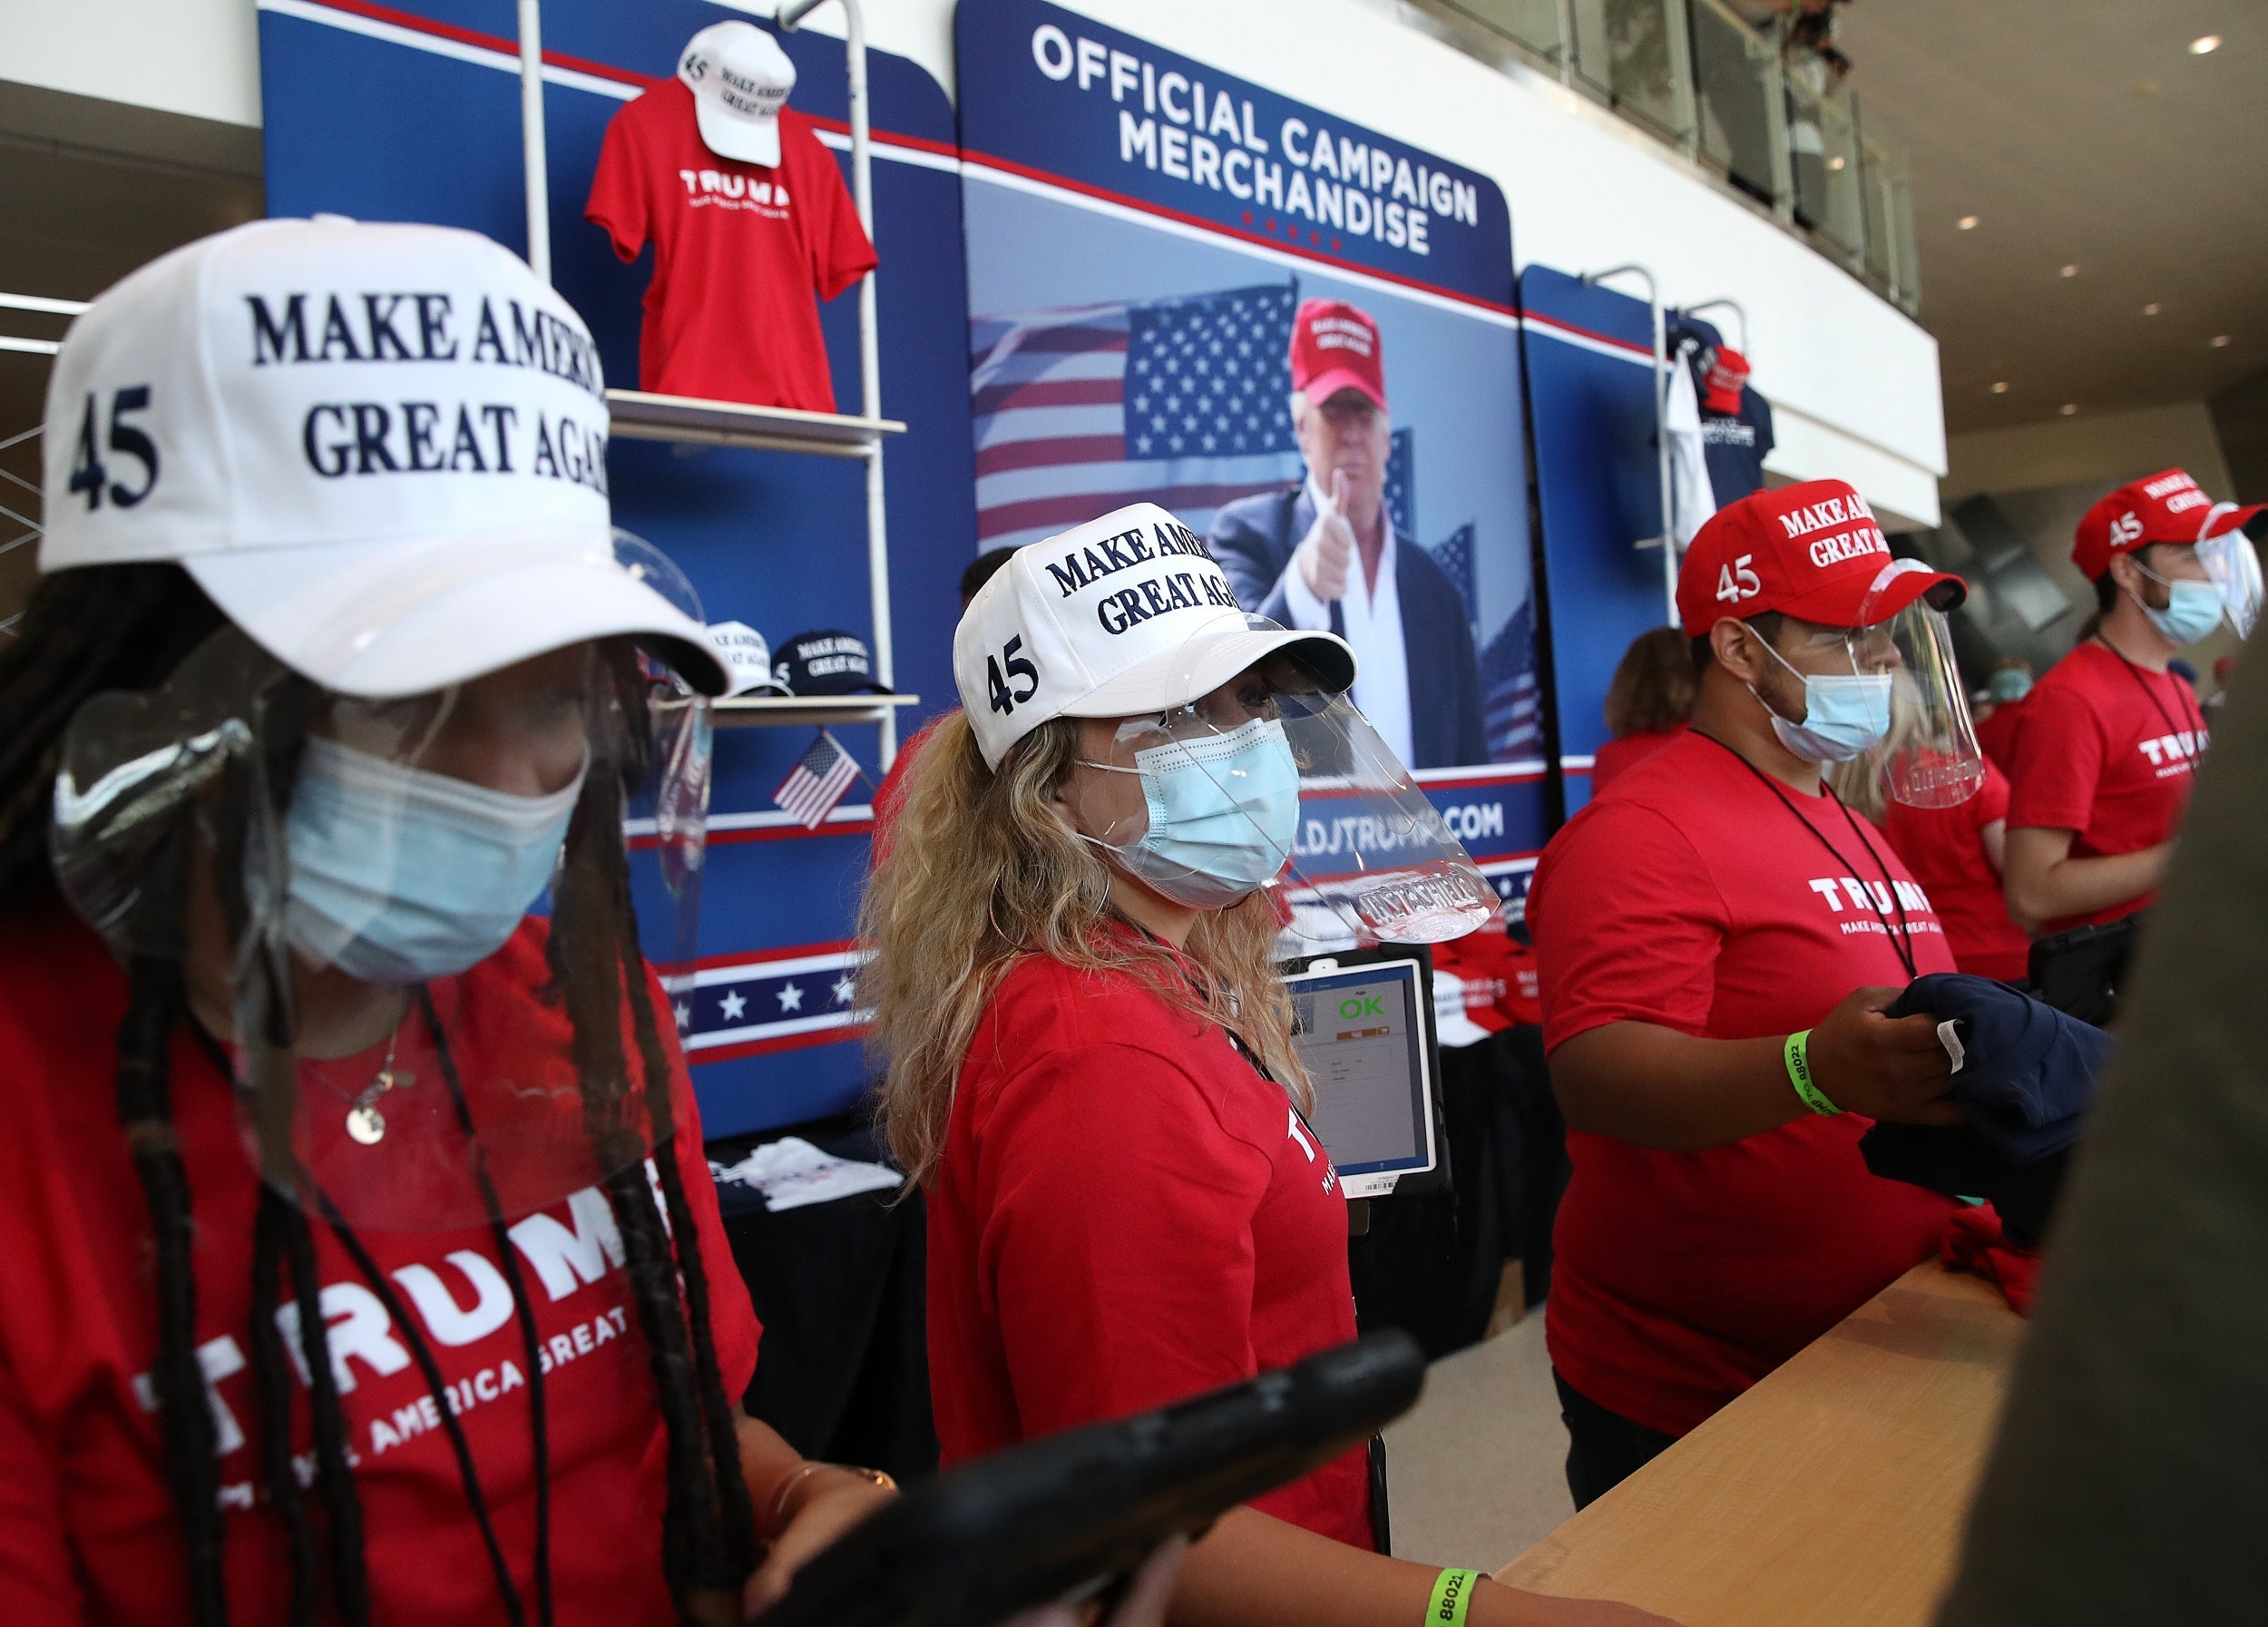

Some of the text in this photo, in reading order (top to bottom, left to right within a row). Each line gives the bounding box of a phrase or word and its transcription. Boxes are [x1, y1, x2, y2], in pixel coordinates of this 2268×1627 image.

[1031, 24, 1478, 226] OFFICIAL CAMPAIGN
[1119, 110, 1430, 256] MERCHANDISE
[244, 293, 456, 367] MAKE
[68, 385, 159, 510] 45
[305, 401, 518, 478] GREAT
[1778, 497, 1848, 539] MAKE
[1809, 528, 1875, 568] GREAT
[2109, 510, 2144, 547] 45
[1045, 528, 1155, 598] MAKE
[1716, 554, 1761, 603] 45
[1098, 573, 1203, 635] GREAT
[987, 634, 1039, 716] 45
[1840, 920, 1871, 935] MAKE
[1339, 995, 1384, 1020] OK
[1791, 1044, 1807, 1080] 88022
[132, 1158, 672, 1454] TRUM
[1440, 1574, 1464, 1621] 88022
